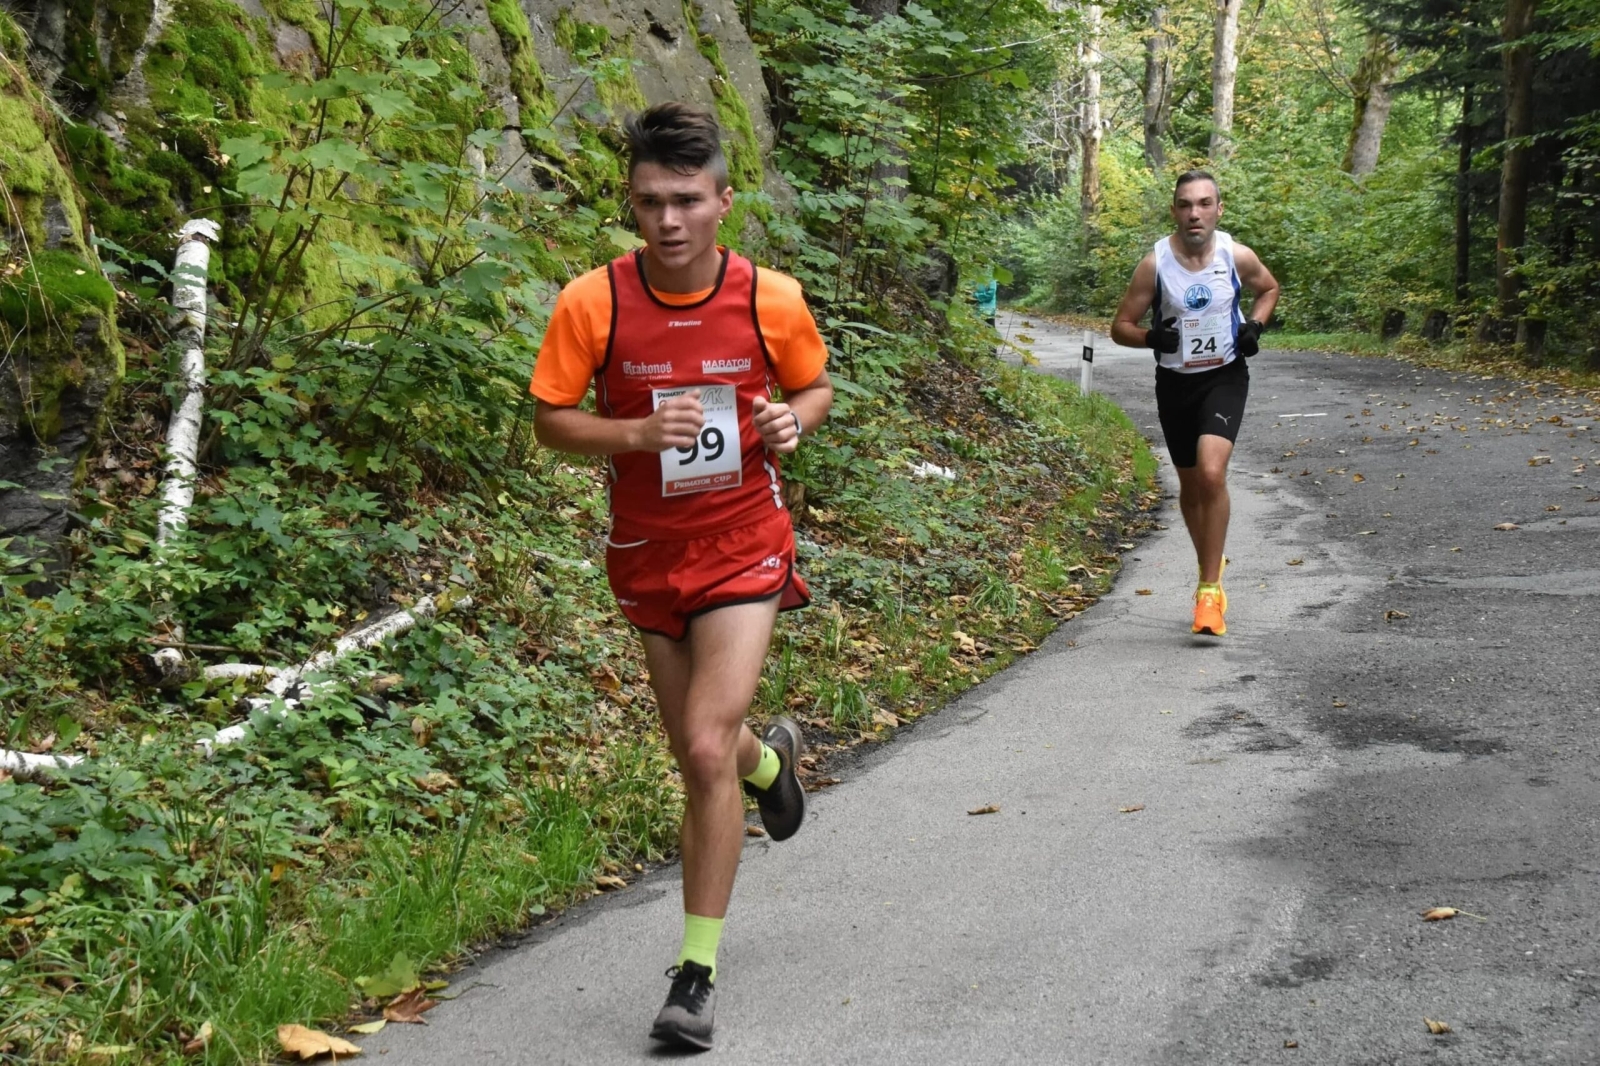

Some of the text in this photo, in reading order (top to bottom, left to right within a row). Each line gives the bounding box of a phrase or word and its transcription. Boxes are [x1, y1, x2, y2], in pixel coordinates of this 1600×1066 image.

[1190, 336, 1217, 355] 24
[622, 360, 672, 375] Krakonoš
[702, 358, 751, 368] MARATON
[674, 478, 711, 490] PRIMATOR
[713, 474, 732, 483] CUP
